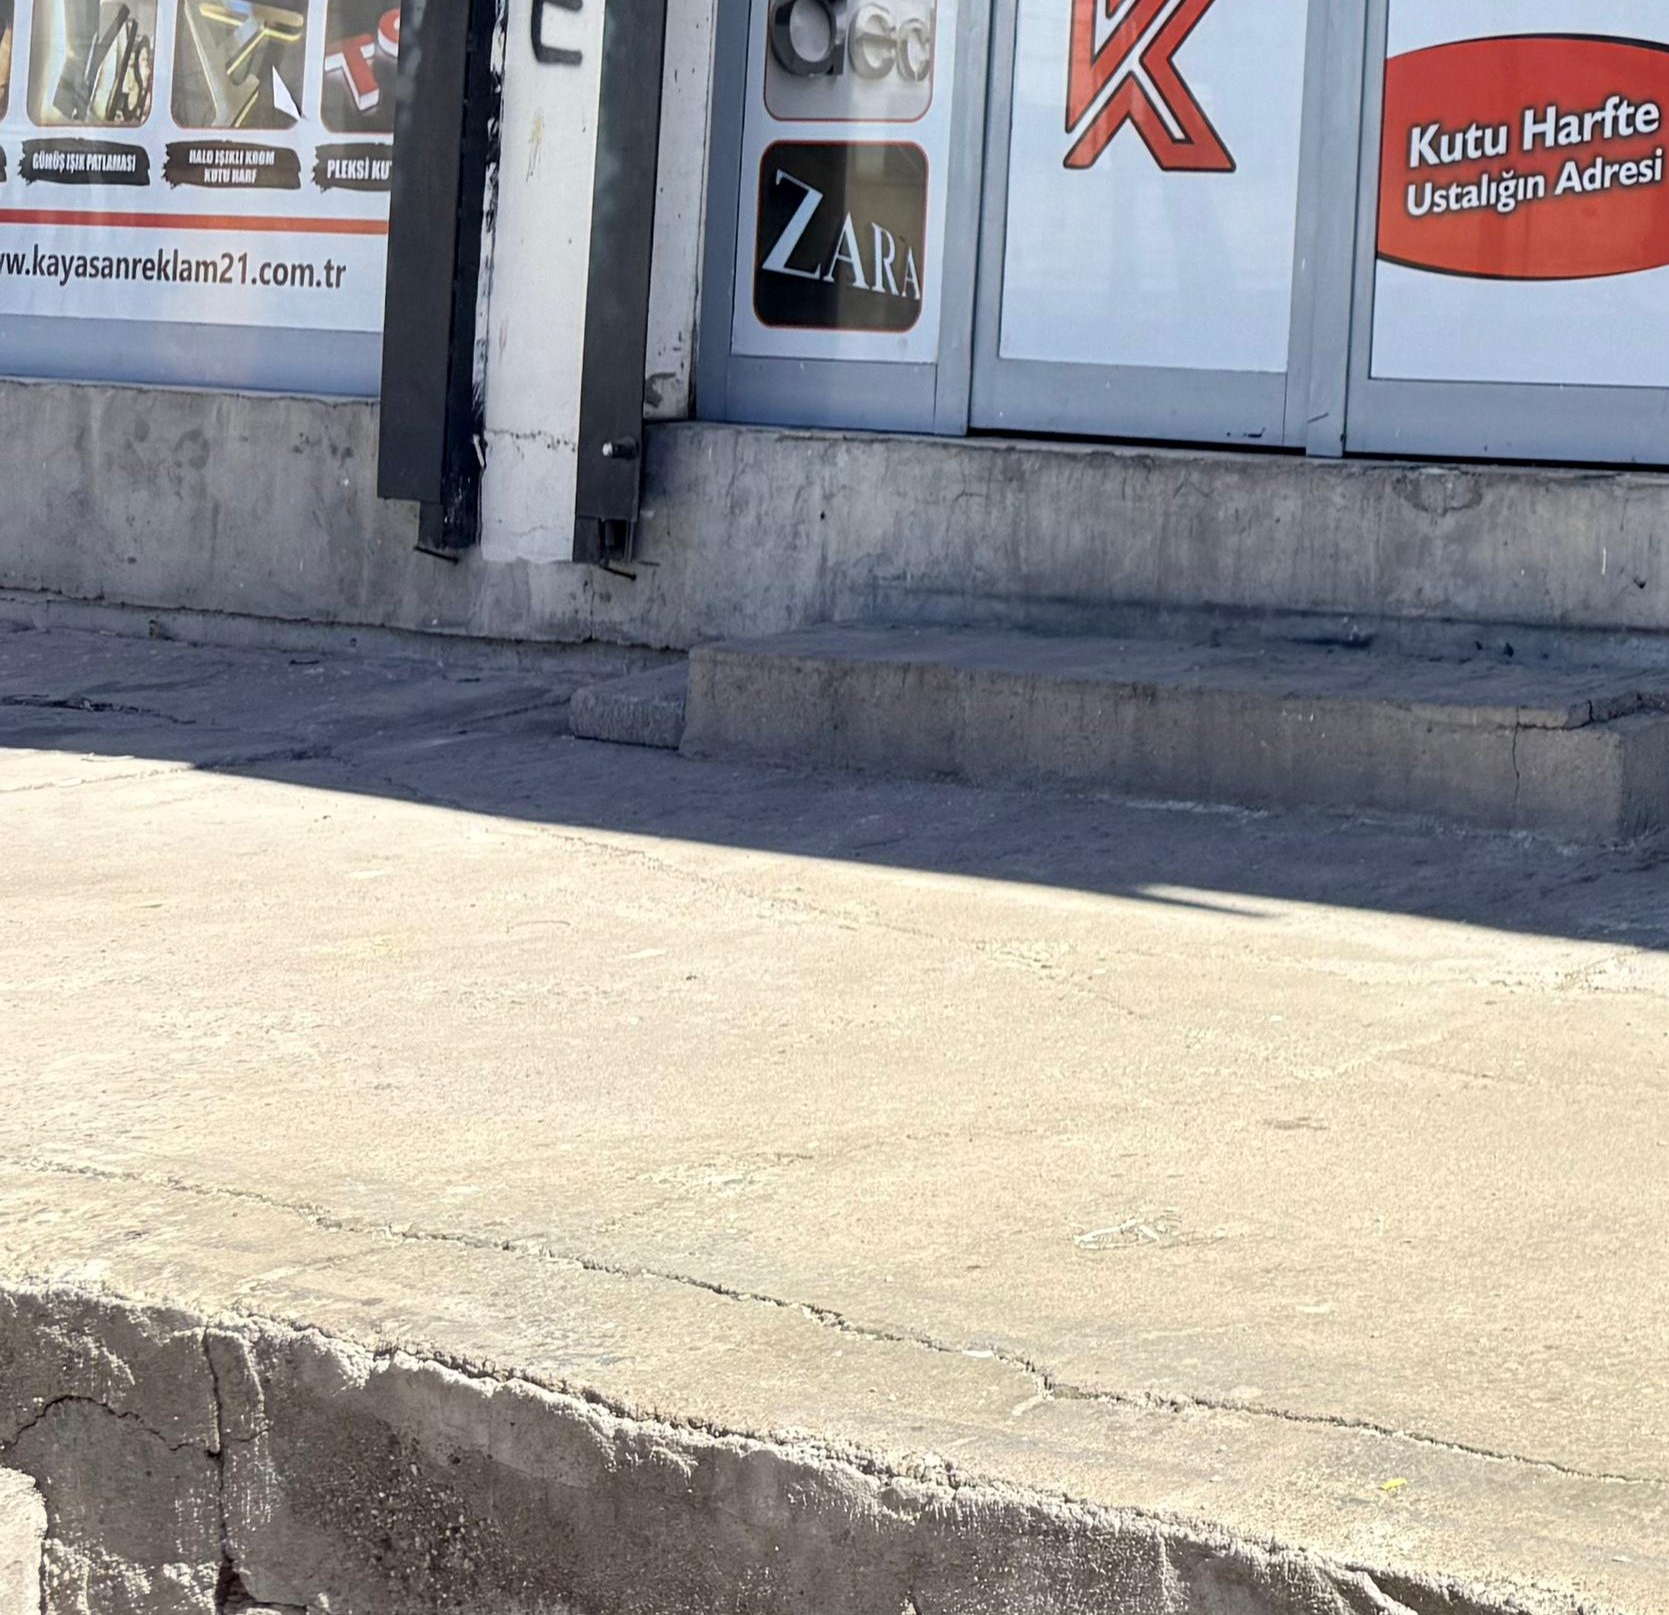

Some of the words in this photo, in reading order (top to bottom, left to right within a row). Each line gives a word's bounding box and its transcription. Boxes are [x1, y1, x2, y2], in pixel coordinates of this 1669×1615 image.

[1408, 115, 1508, 169] Kutu
[1522, 94, 1661, 155] Harfte
[204, 168, 230, 183] KUTU
[231, 169, 257, 184] HARF
[1405, 169, 1546, 217] Ustalığın
[1554, 149, 1664, 196] Adresi
[762, 169, 920, 300] ZARA
